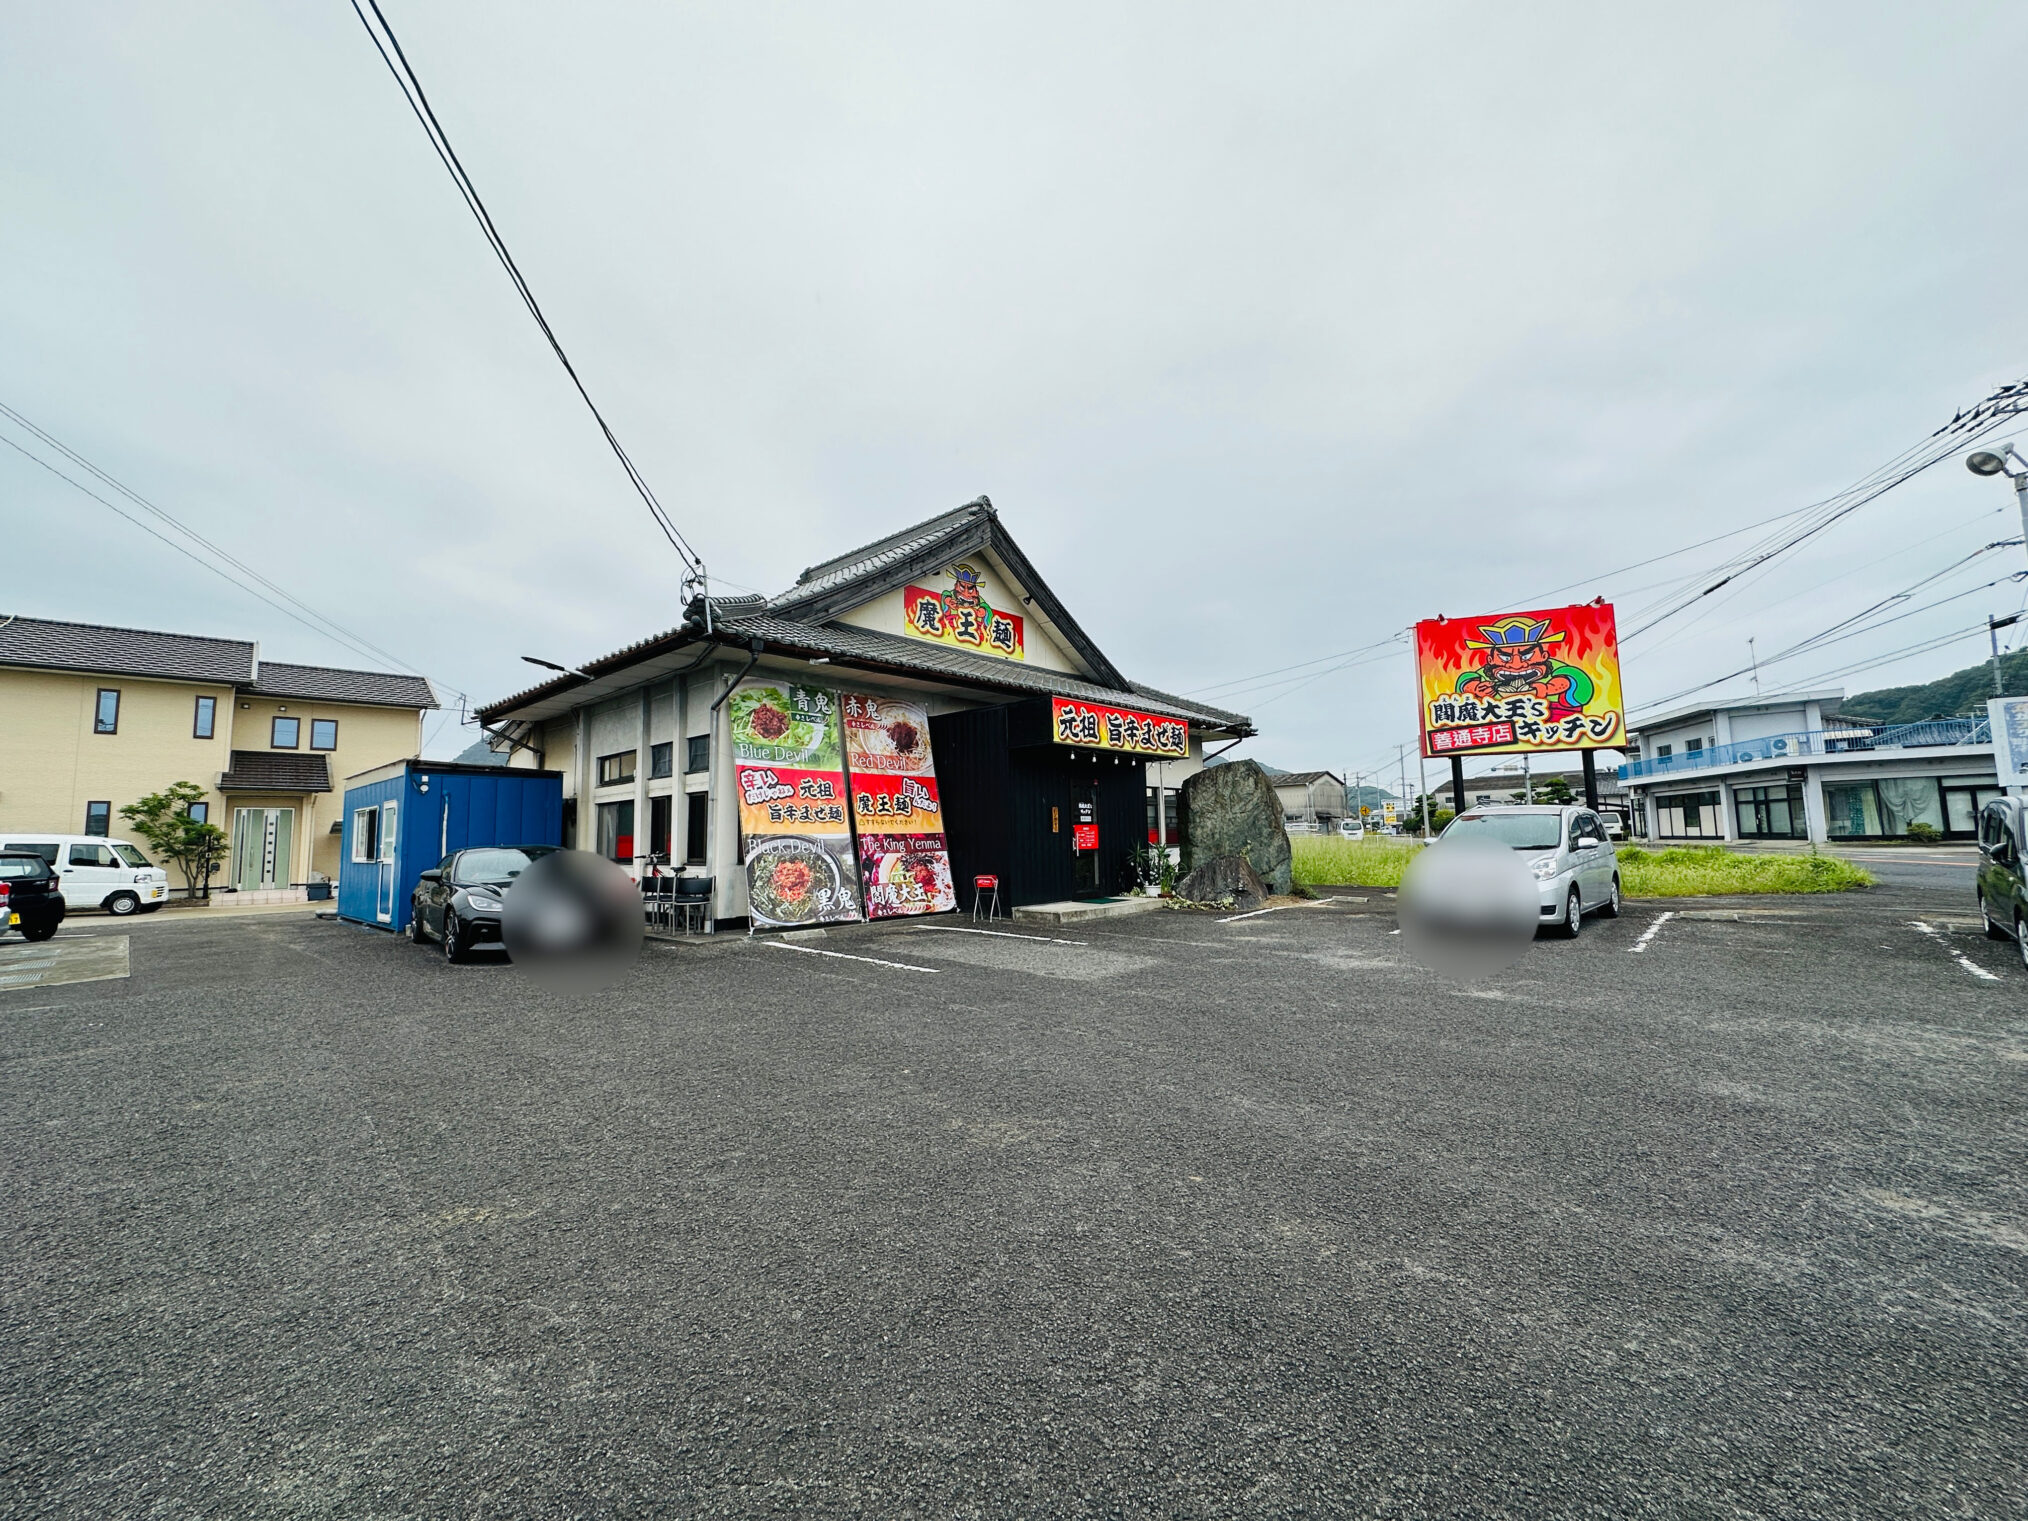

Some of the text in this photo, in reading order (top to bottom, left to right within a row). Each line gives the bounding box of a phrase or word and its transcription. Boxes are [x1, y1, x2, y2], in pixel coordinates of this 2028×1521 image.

[915, 598, 1012, 650] 魔王麺
[793, 689, 832, 715] 青鬼
[846, 696, 881, 721] 赤鬼
[1060, 707, 1184, 753] 元祖 旨辛まぜ麺
[1433, 725, 1512, 749] 善通寺店
[1518, 715, 1613, 741] キッチン
[740, 743, 809, 762] Blue Devil
[850, 752, 906, 771] Red Devil
[800, 779, 834, 798] 元祖
[768, 804, 843, 821] 旨辛まぜ麺
[857, 793, 911, 814] 魔王麺
[747, 838, 825, 854] Black Devil
[860, 838, 942, 852] The King Yenma
[816, 887, 857, 910] 黒鬼
